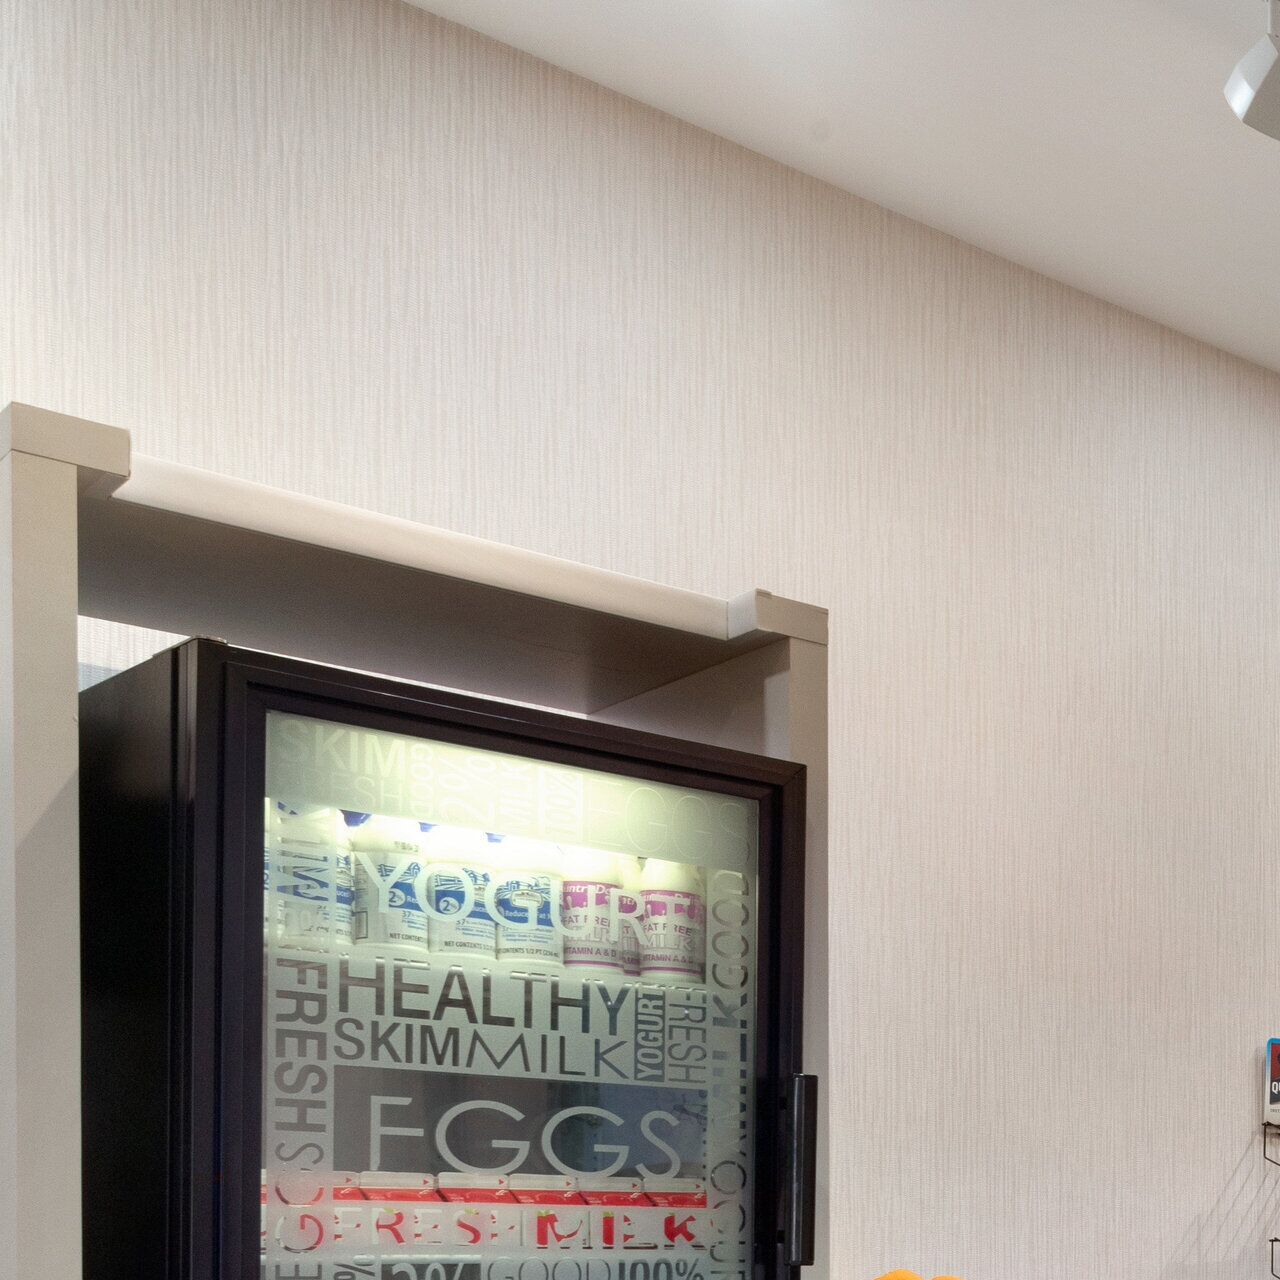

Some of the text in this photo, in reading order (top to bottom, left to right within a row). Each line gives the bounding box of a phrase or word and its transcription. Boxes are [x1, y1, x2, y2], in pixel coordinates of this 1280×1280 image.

[354, 850, 690, 948] YOGURT
[402, 934, 425, 942] CONTENT
[711, 868, 749, 990] GOOD
[339, 956, 632, 1036] HEALTHY
[637, 987, 664, 1081] YOGURT
[667, 988, 708, 1084] FRESH
[275, 957, 328, 1135] FRESH
[333, 1018, 630, 1080] SKIM MILK
[369, 1095, 681, 1179] EGGS
